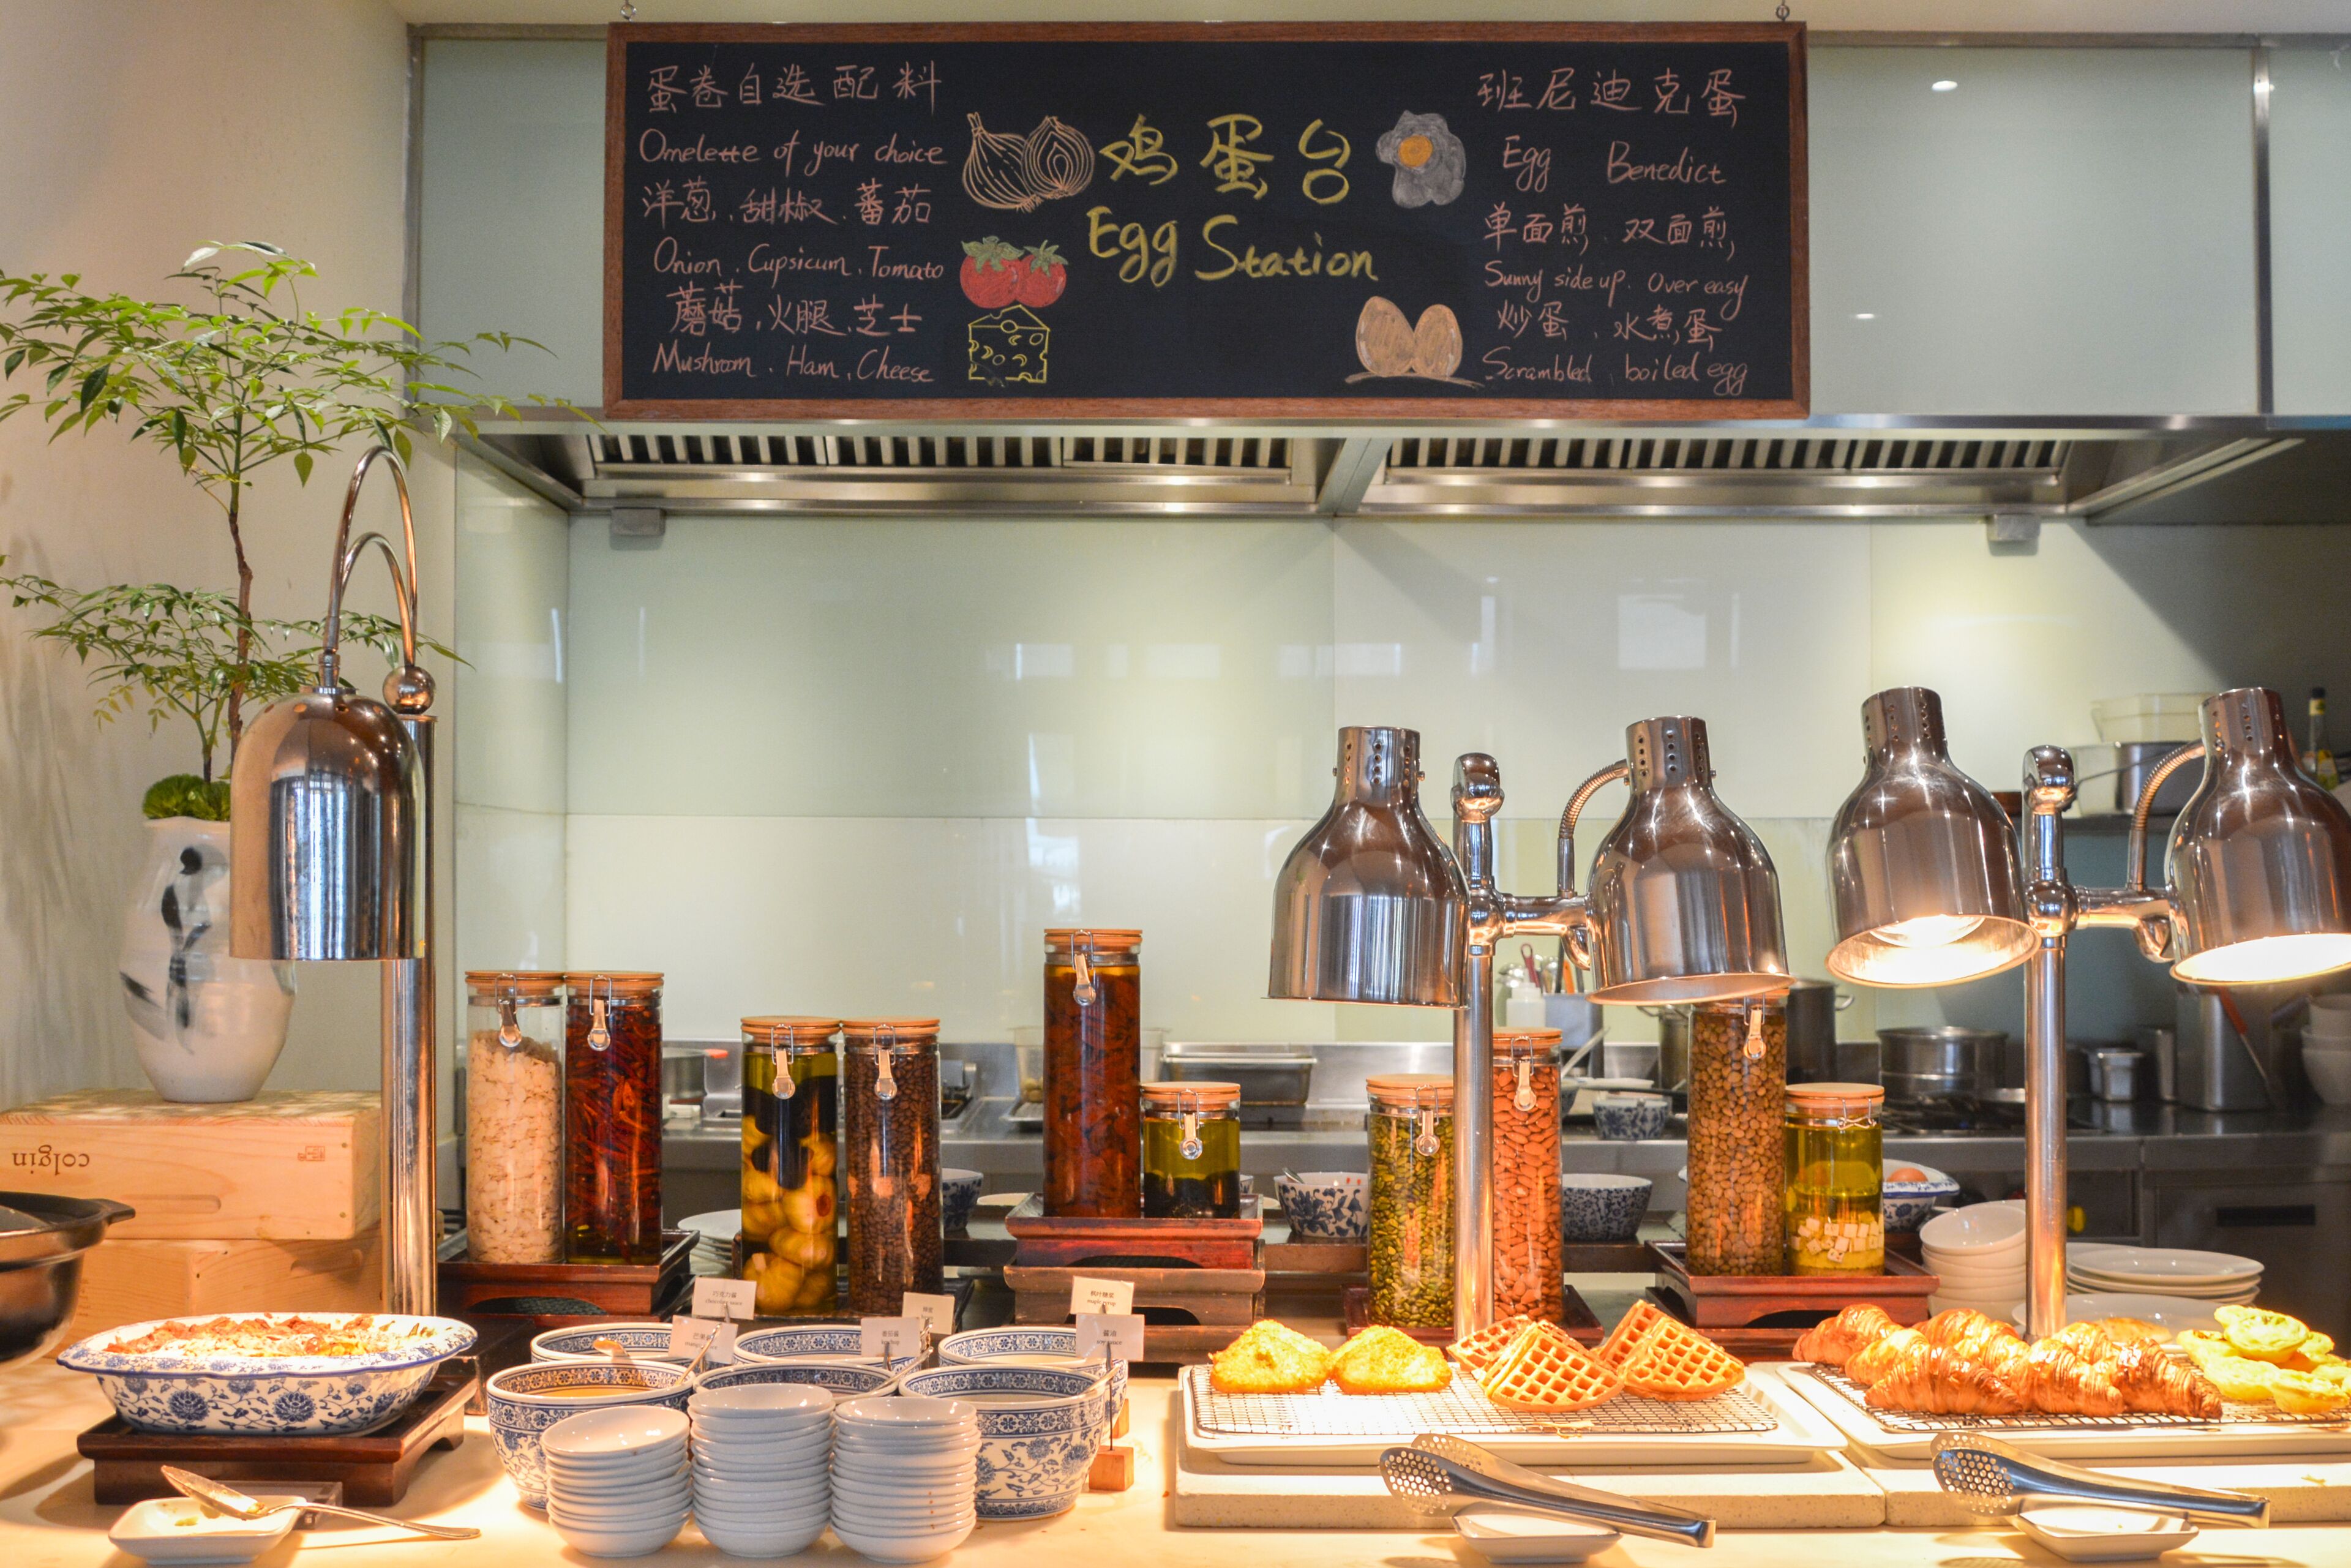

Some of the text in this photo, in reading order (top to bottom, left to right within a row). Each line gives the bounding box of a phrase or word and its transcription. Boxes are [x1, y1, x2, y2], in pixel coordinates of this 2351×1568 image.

[648, 61, 942, 115] 蛋卷自选配料
[1477, 67, 1746, 127] 班尼迪克蛋
[639, 128, 948, 178] Omelette of your choice
[1098, 114, 1351, 205] 鸡蛋台
[1502, 134, 1727, 193] Egg Benedict
[868, 246, 945, 280] Tomato
[1086, 206, 1379, 289] Egg Station
[1484, 260, 1544, 304] Sunny
[1554, 264, 1593, 290] side
[1647, 271, 1699, 294] Over
[1704, 274, 1749, 321] easy
[857, 345, 936, 383] Cheese
[1482, 346, 1749, 396] Scrambled boiled egg
[12, 1144, 90, 1176] colgin
